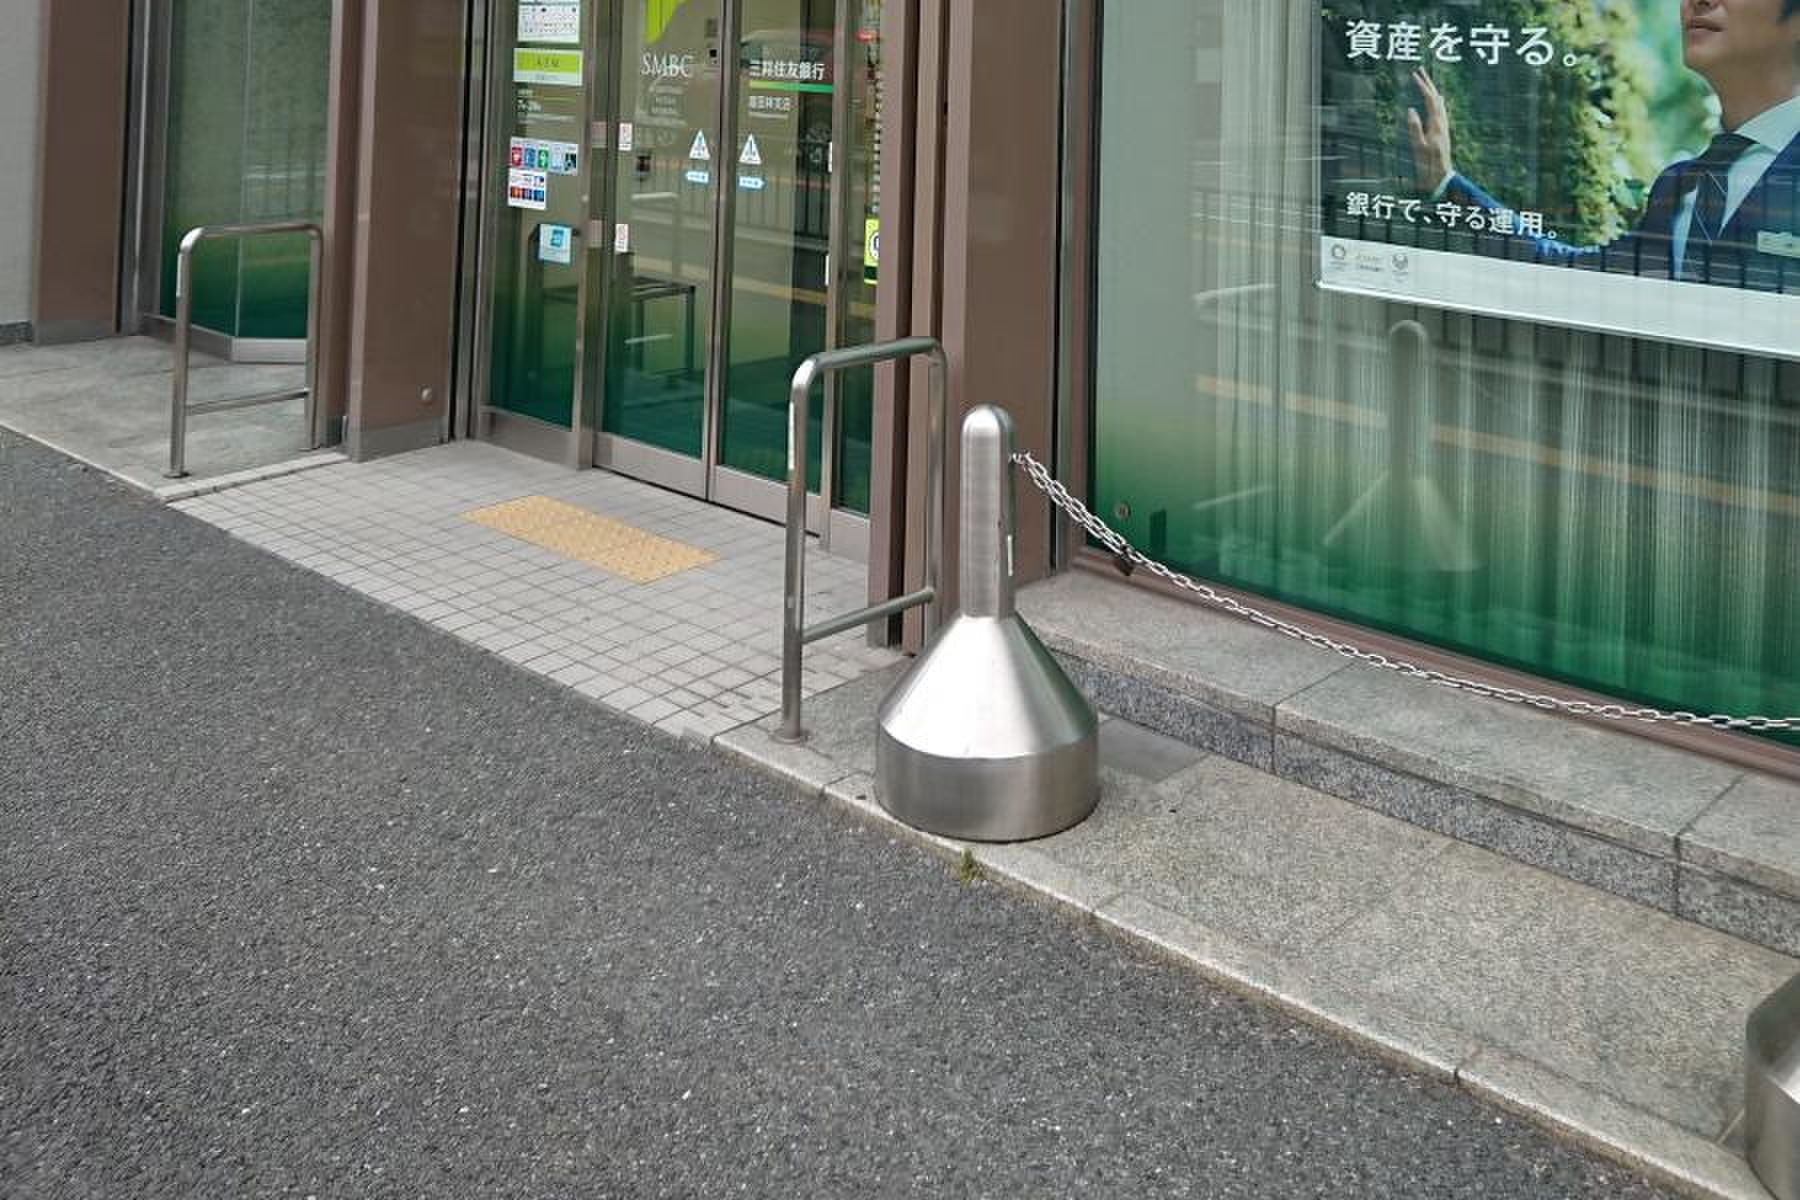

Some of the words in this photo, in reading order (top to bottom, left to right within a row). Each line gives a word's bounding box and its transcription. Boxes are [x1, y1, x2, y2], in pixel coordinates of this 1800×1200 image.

[1345, 20, 1581, 67] 資産を守る。
[641, 52, 694, 78] SMBC
[749, 59, 825, 81] 三井住友銀行
[1346, 191, 1558, 240] 銀行で、守る運用。
